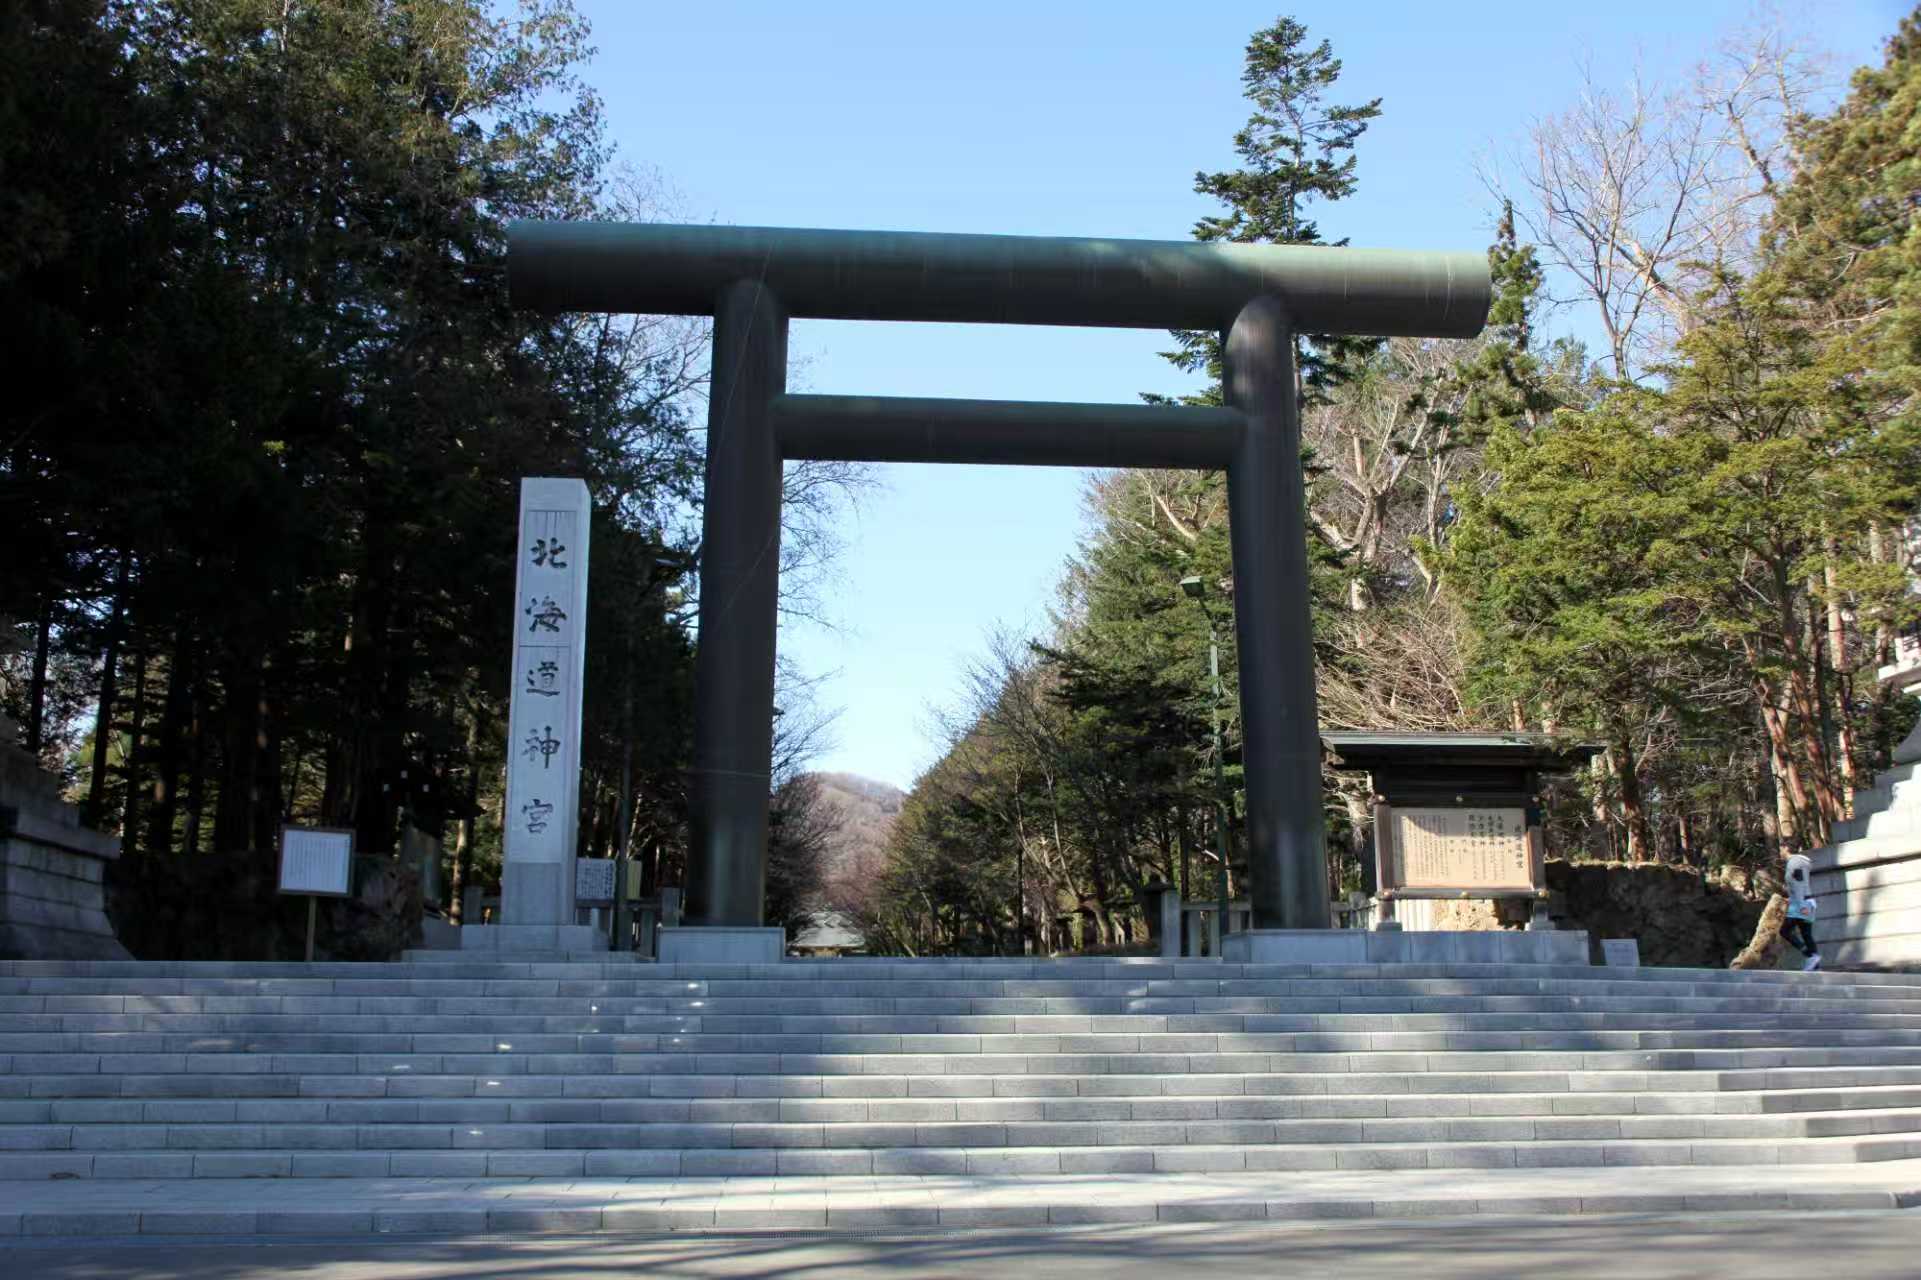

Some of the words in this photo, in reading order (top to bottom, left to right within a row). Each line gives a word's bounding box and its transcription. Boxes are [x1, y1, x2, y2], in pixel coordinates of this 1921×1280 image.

[522, 538, 567, 833] 北海道神宮
